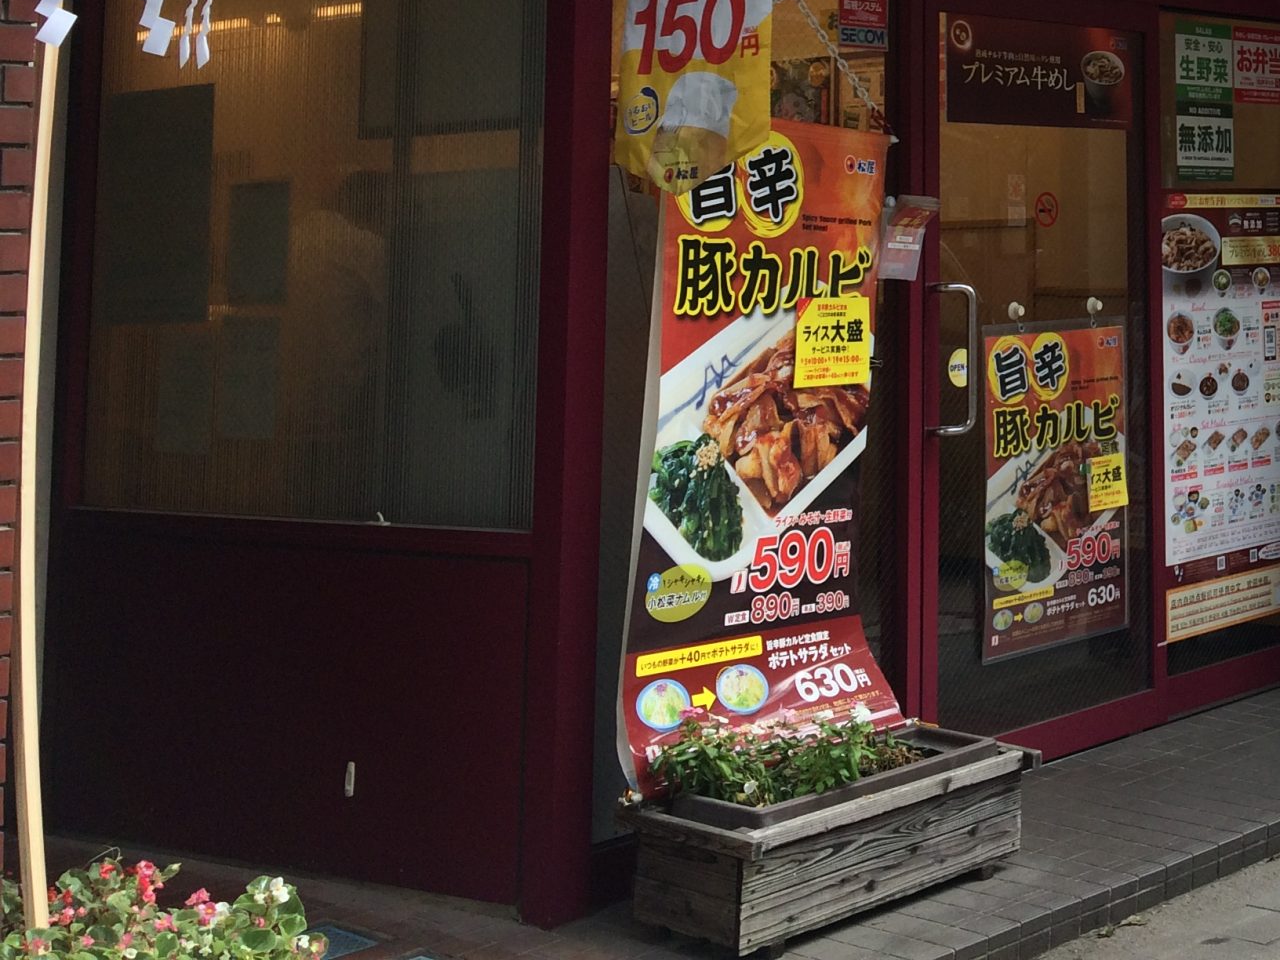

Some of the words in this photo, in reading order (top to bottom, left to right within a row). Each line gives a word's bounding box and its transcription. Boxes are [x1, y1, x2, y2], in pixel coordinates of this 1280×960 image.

[841, 27, 885, 45] SECOM
[961, 60, 1076, 91] プレミアム牛めし
[1179, 54, 1229, 84] 生野菜
[1178, 123, 1232, 154] 無添加
[674, 235, 872, 315] 豚カルビ
[803, 318, 864, 343] ライス大盛
[994, 341, 1065, 400] 旨辛
[993, 395, 1120, 458] 豚カルビ
